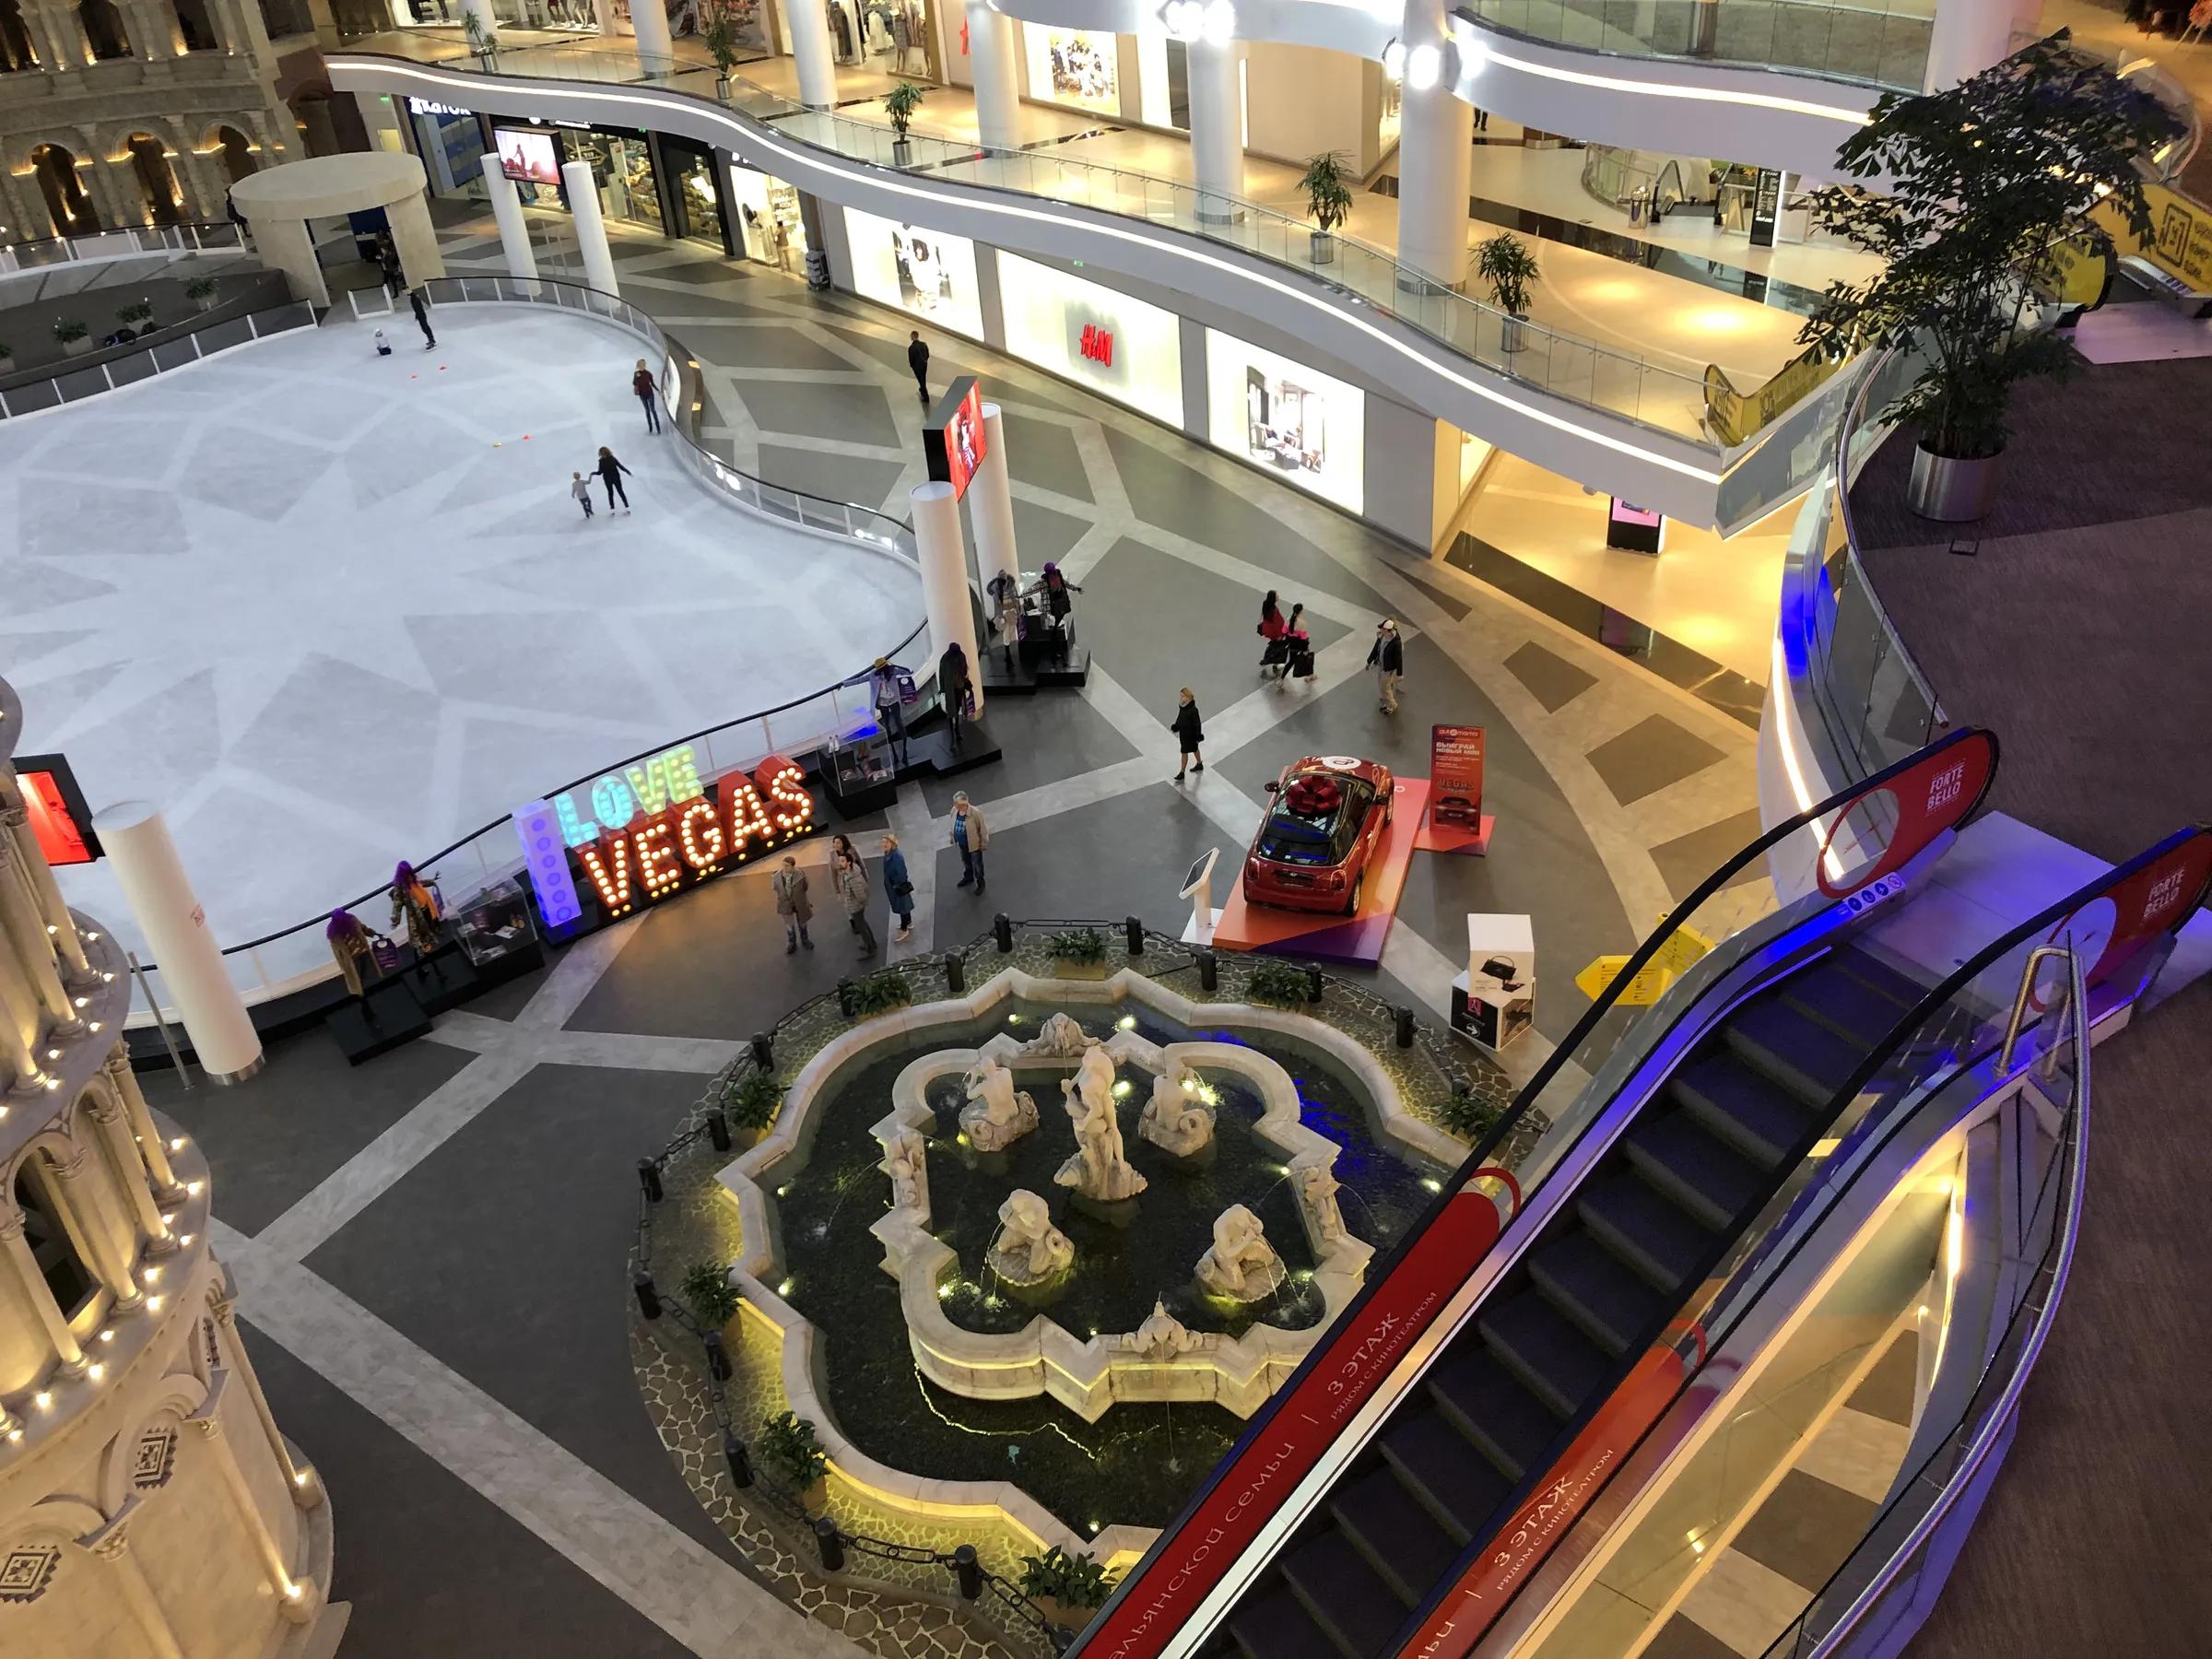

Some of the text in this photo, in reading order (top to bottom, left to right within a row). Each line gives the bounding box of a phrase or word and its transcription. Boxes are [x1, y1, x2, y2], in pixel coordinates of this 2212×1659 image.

[1079, 324, 1113, 368] H&M
[1436, 741, 1476, 750] ВЫИГРАЙ
[1929, 764, 1965, 794] FORTE
[555, 745, 704, 848] LOVE
[573, 755, 814, 907] VEGAS
[1927, 781, 1960, 810] BELLO
[1327, 1380, 1345, 1395] 3
[1342, 1312, 1400, 1378] ЭТАЖ
[1330, 1380, 1366, 1420] РЯДОМ
[1371, 1291, 1438, 1371] КИНОТЕАТРОМ
[1494, 1551, 1511, 1567] 3
[1510, 1475, 1574, 1547] ЭТАЖ
[1496, 1547, 1535, 1591] РЯДОМ
[1541, 1448, 1614, 1536] КИНОТЕАТРОМ
